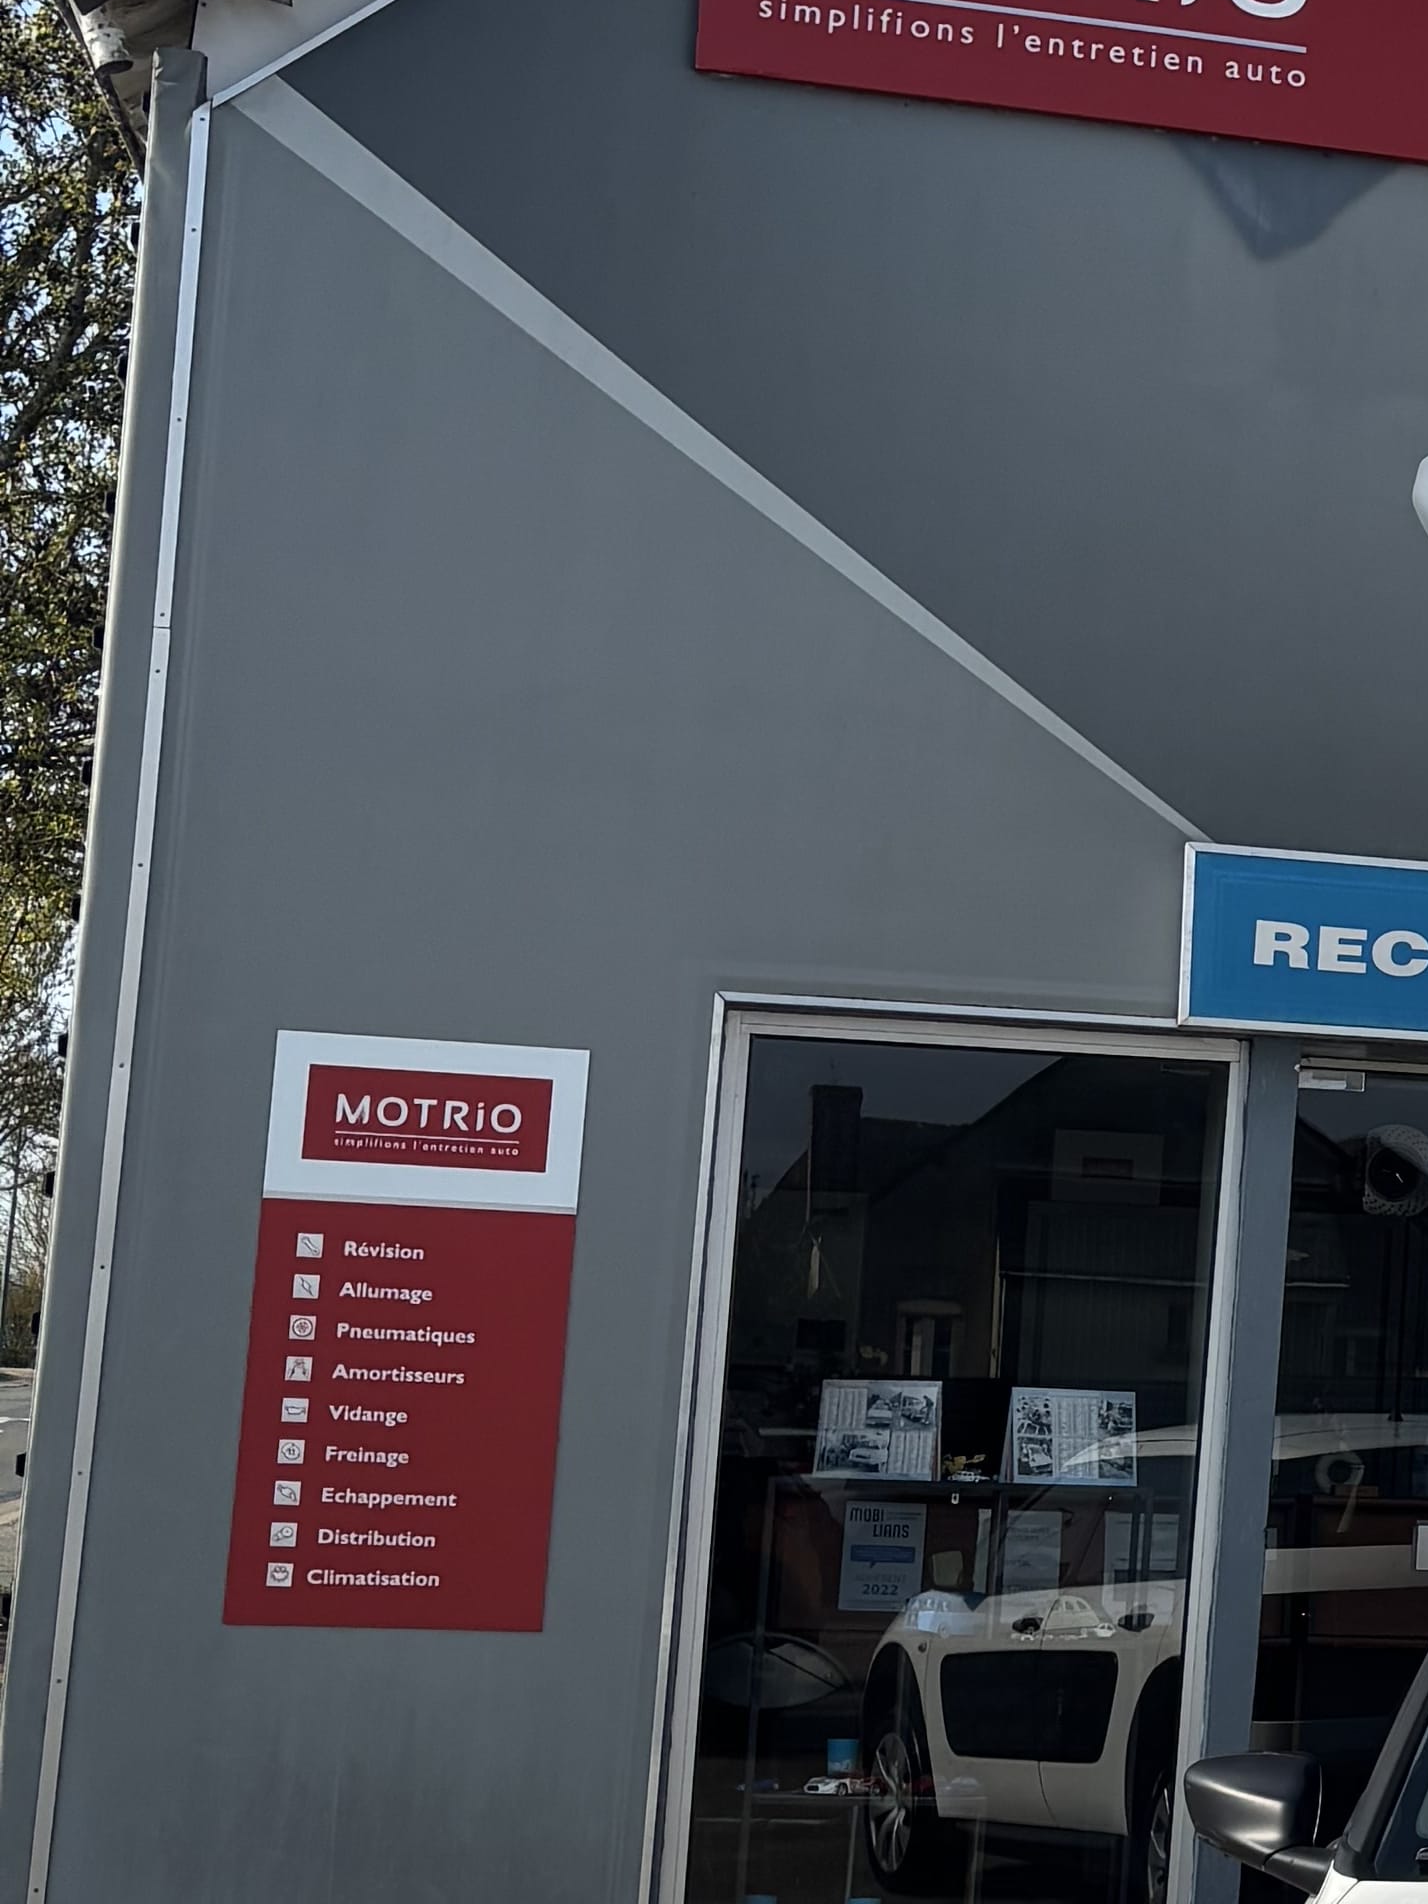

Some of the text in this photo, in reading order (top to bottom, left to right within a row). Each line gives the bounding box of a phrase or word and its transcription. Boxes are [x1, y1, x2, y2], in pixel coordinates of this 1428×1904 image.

[996, 21, 1204, 74] l'entretien
[1224, 57, 1307, 88] auto
[490, 1147, 519, 1157] auto
[344, 1238, 425, 1261] Révision
[339, 1281, 433, 1305] Allumage
[336, 1322, 476, 1347] Pneumatiques
[331, 1363, 466, 1385] Amortisseurs
[328, 1404, 409, 1427] Vidange
[324, 1445, 410, 1468] Freinage
[320, 1486, 458, 1510] Echappement
[849, 1507, 885, 1522] MOBI
[317, 1528, 436, 1548] Distribution
[306, 1568, 441, 1588] Climatisation
[861, 1583, 899, 1596] 2022
